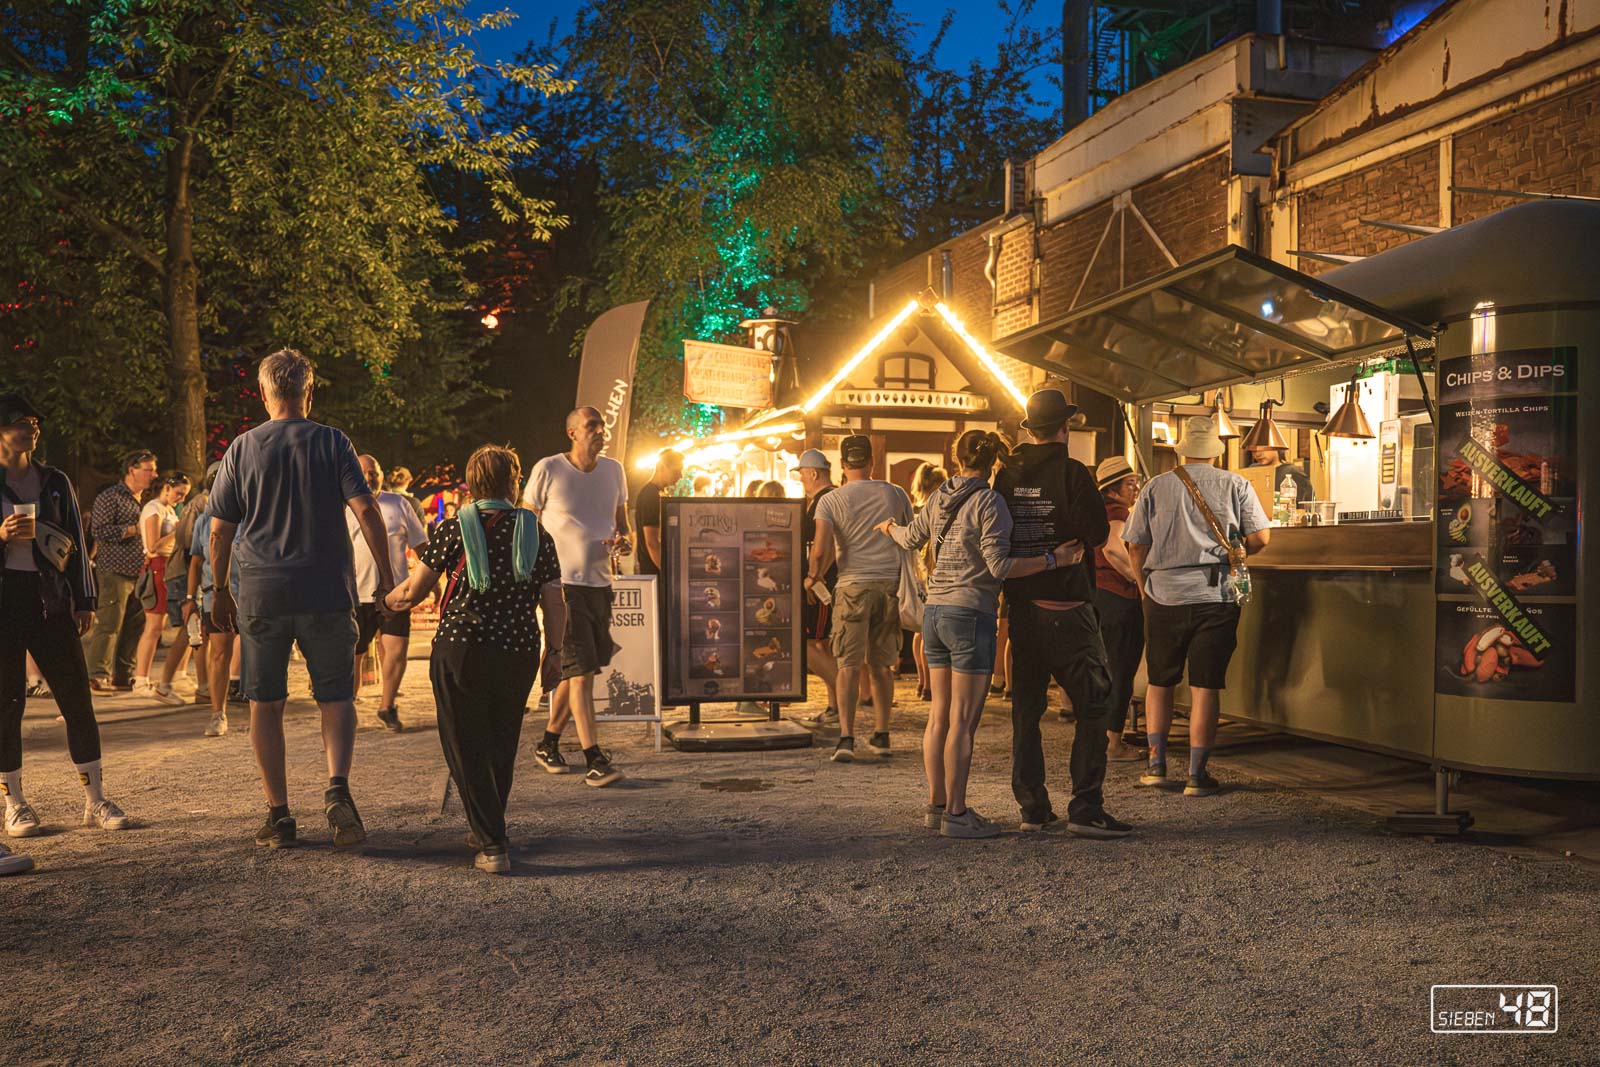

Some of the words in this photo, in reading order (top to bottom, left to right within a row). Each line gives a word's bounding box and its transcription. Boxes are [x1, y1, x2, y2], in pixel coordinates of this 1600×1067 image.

[1446, 370, 1494, 387] CHIPS
[1497, 366, 1512, 380] &
[1517, 364, 1565, 379] DIPS
[1460, 441, 1552, 519] AUSVERKAUFT
[1467, 561, 1552, 653] AUSVERKAUFT
